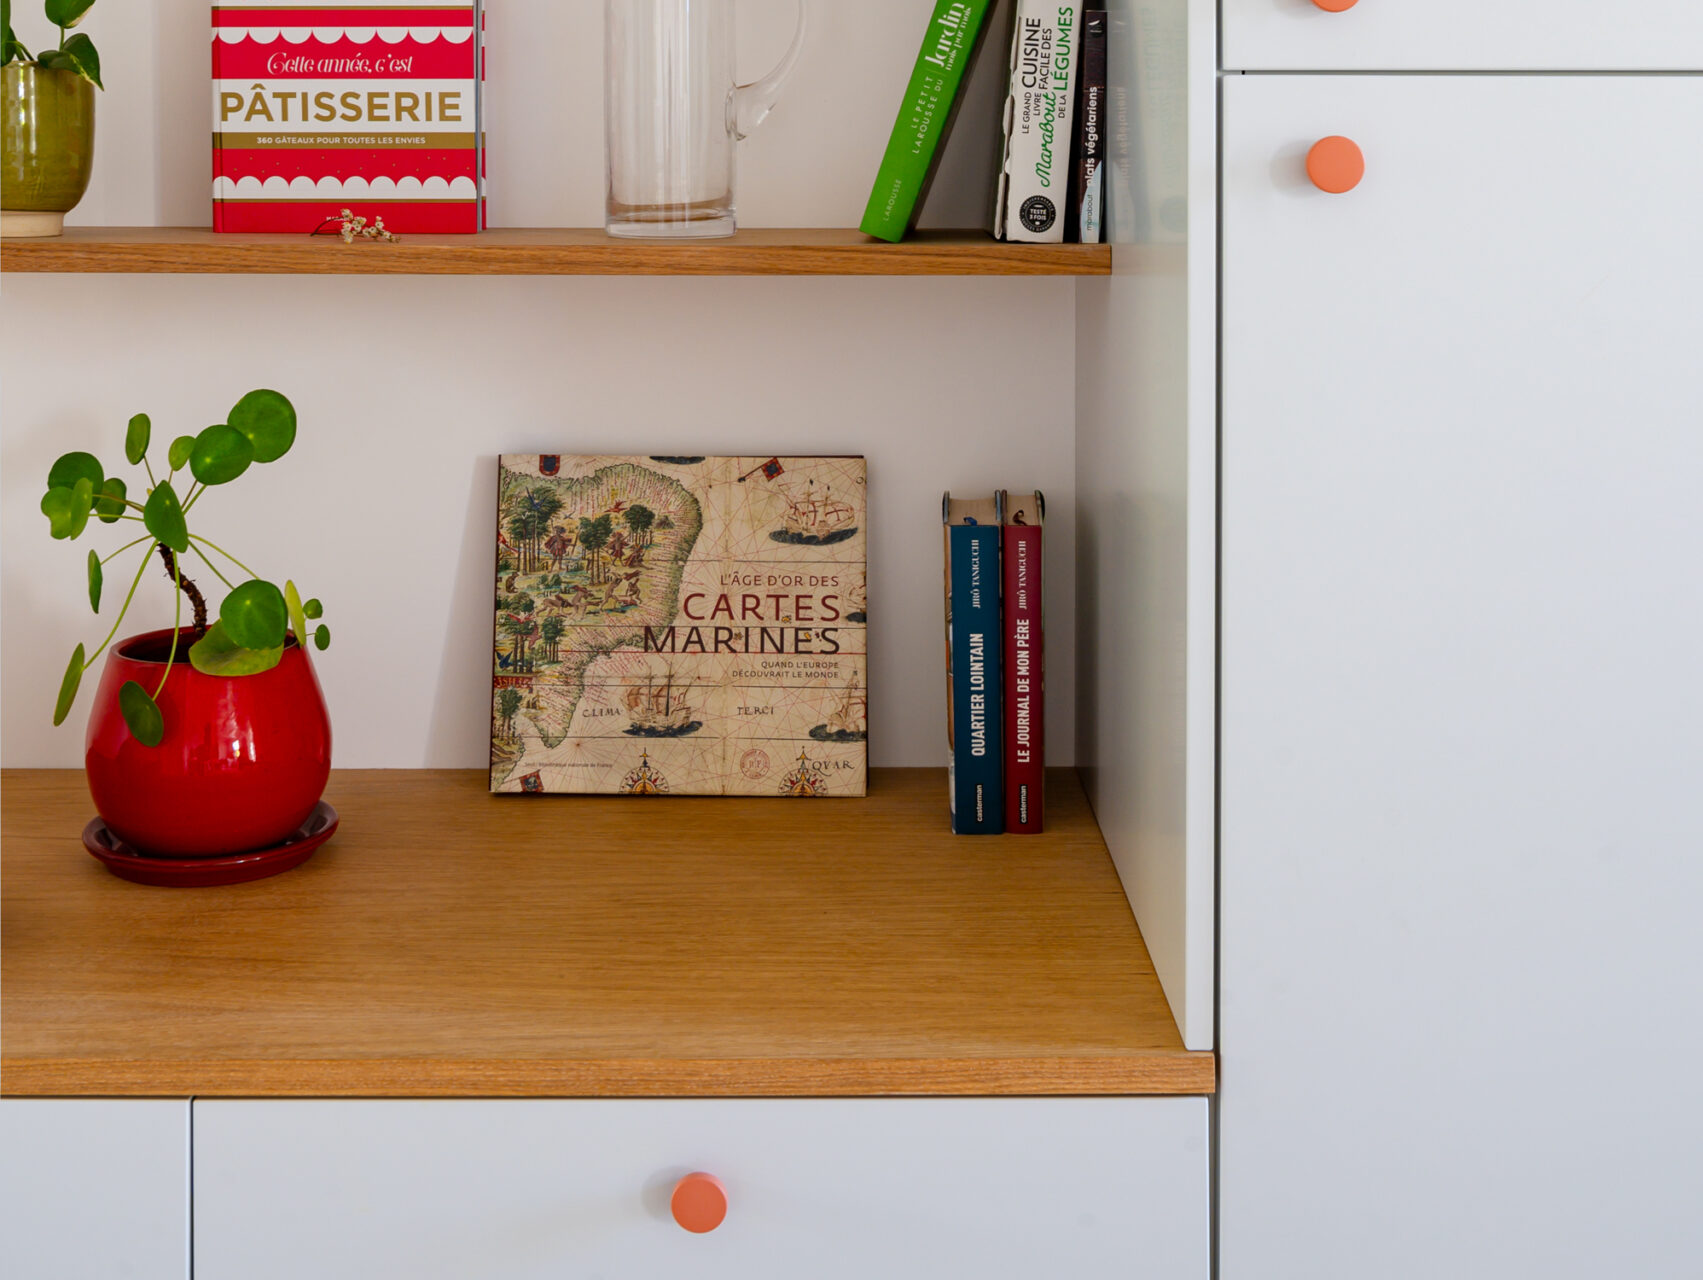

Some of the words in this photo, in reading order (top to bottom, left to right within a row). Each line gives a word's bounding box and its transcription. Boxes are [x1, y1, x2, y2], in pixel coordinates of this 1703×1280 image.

[924, 2, 965, 67] Jardin
[1041, 28, 1053, 50] DES
[1050, 6, 1074, 91] LÉGUMES
[267, 51, 314, 75] Cette
[1021, 17, 1041, 88] CUISINE
[1038, 52, 1051, 90] FACILE
[220, 83, 462, 122] PÂTISSERIE
[915, 76, 934, 113] PETIT
[1022, 91, 1032, 124] GRAND
[1033, 92, 1042, 116] LIVRE
[1059, 94, 1067, 106] LA
[912, 95, 938, 154] LAROUSSE
[934, 79, 944, 92] DU
[1058, 107, 1066, 119] DE
[1084, 86, 1099, 155] végétariens
[256, 136, 273, 144] 360
[275, 135, 315, 144] GÂTEAUX
[317, 136, 341, 144] POUR
[342, 136, 376, 144] TOUTES
[377, 136, 393, 144] LES
[395, 136, 426, 144] ENVIES
[1022, 124, 1030, 134] LE
[1035, 91, 1056, 188] Marabout
[882, 179, 902, 221] LAROUSSE
[720, 571, 762, 586] L'ÂGE
[767, 575, 804, 587] D'OR
[809, 576, 839, 587] DES
[683, 593, 840, 622] CARTES
[643, 625, 840, 655] MARINES
[1014, 619, 1030, 648] PÈRE
[732, 669, 790, 678] DÉCOUVRAIT
[804, 671, 839, 679] MONDE
[761, 661, 794, 669] QUAND
[796, 661, 839, 669] L'EUROPE
[969, 633, 985, 691] LOINTAIN
[1017, 650, 1030, 676] MON
[1017, 678, 1030, 693] DE
[970, 693, 986, 757] QUARTIER
[1017, 695, 1030, 747] JOURNAL
[1017, 750, 1030, 763] LE
